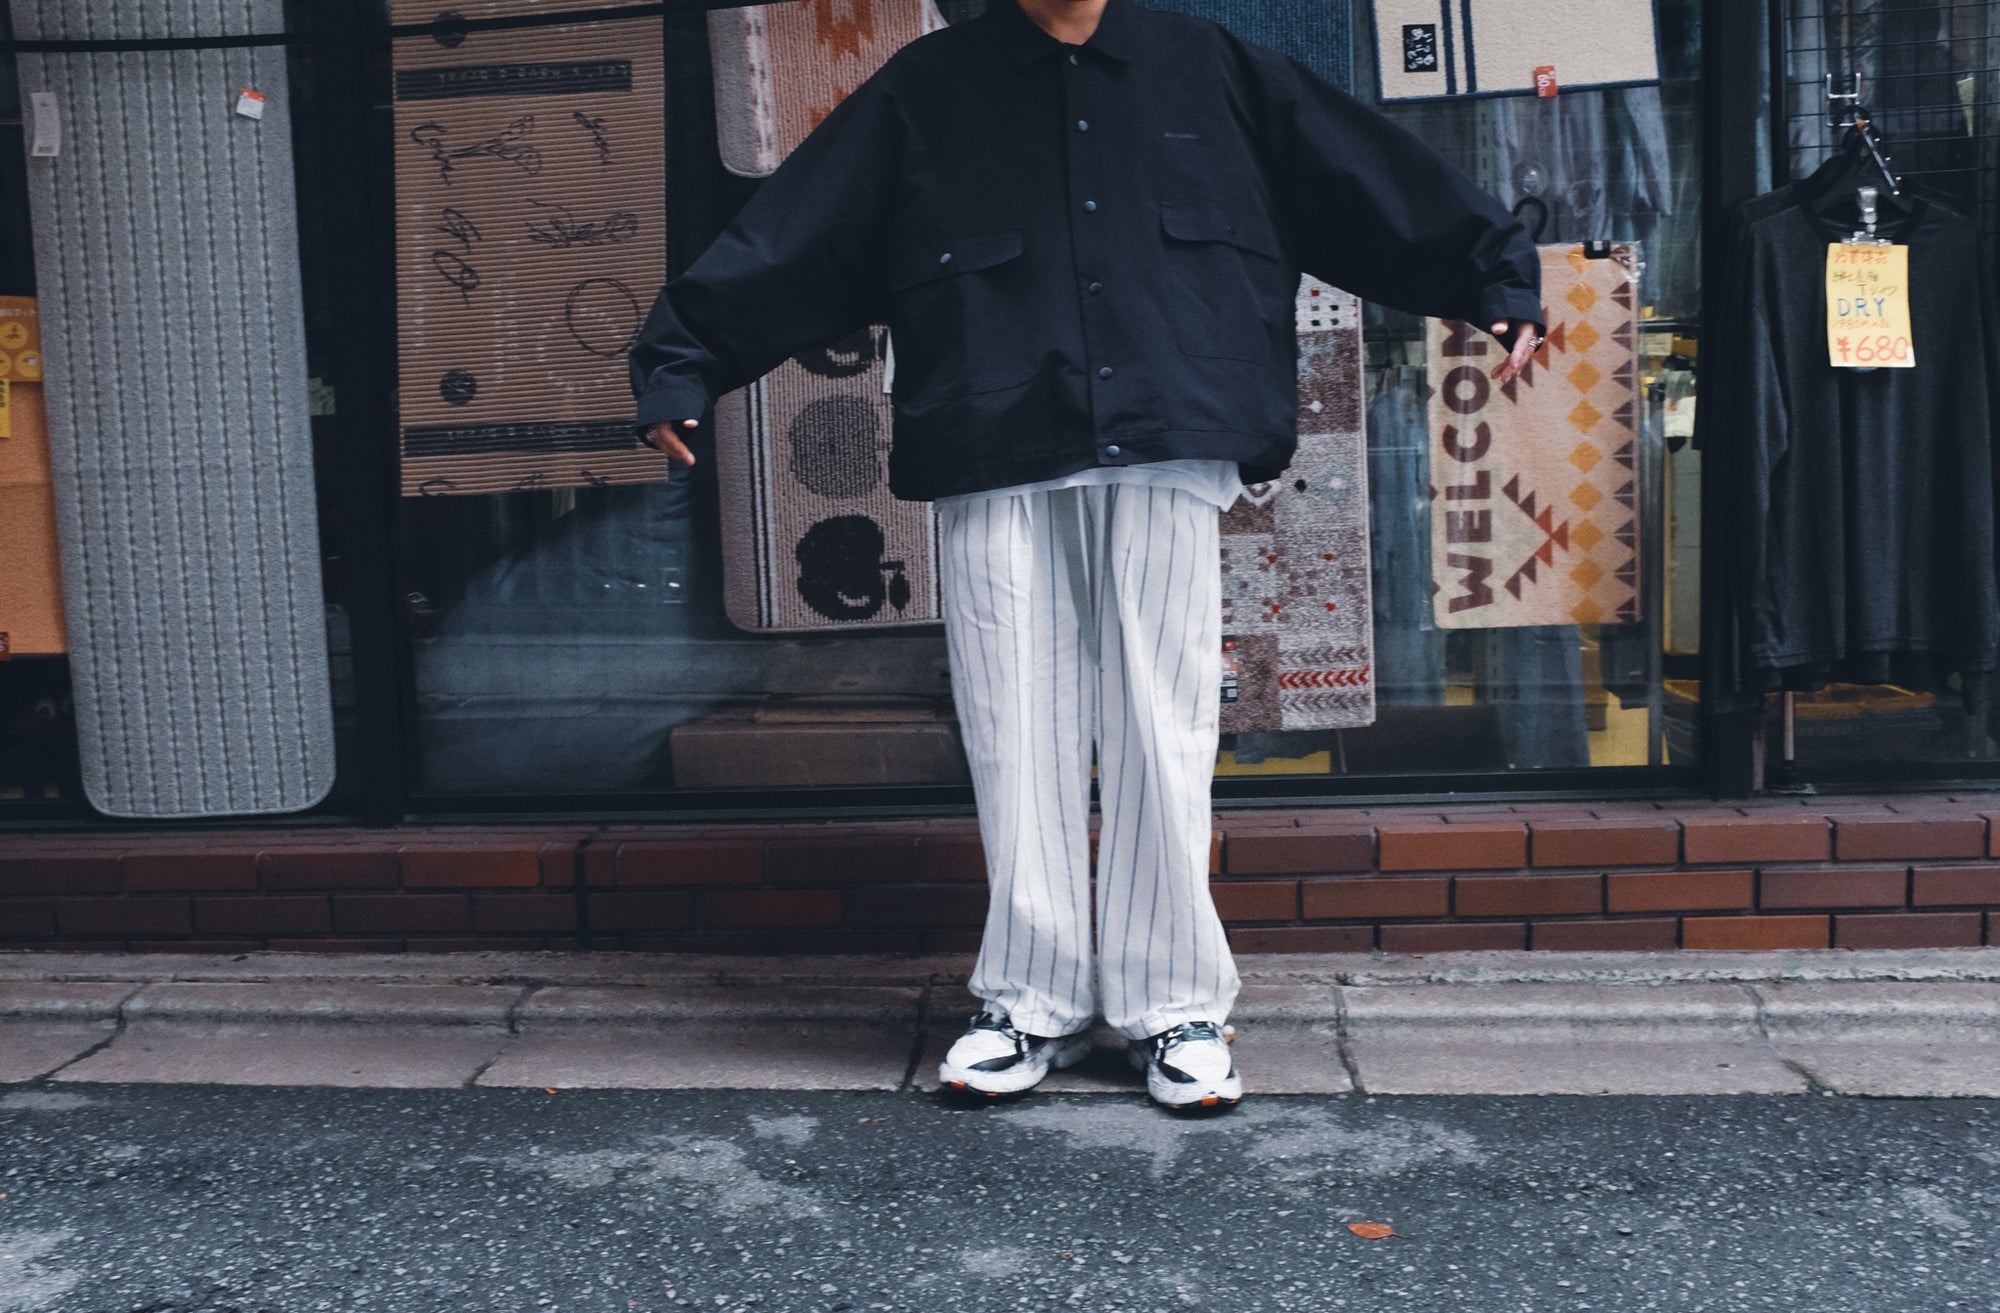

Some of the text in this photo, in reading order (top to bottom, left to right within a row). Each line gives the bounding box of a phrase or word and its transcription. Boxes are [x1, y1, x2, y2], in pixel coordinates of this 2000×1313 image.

[1837, 297, 1886, 318] DRY
[1836, 335, 1910, 362] ¥680
[1441, 318, 1494, 614] WELCOM
